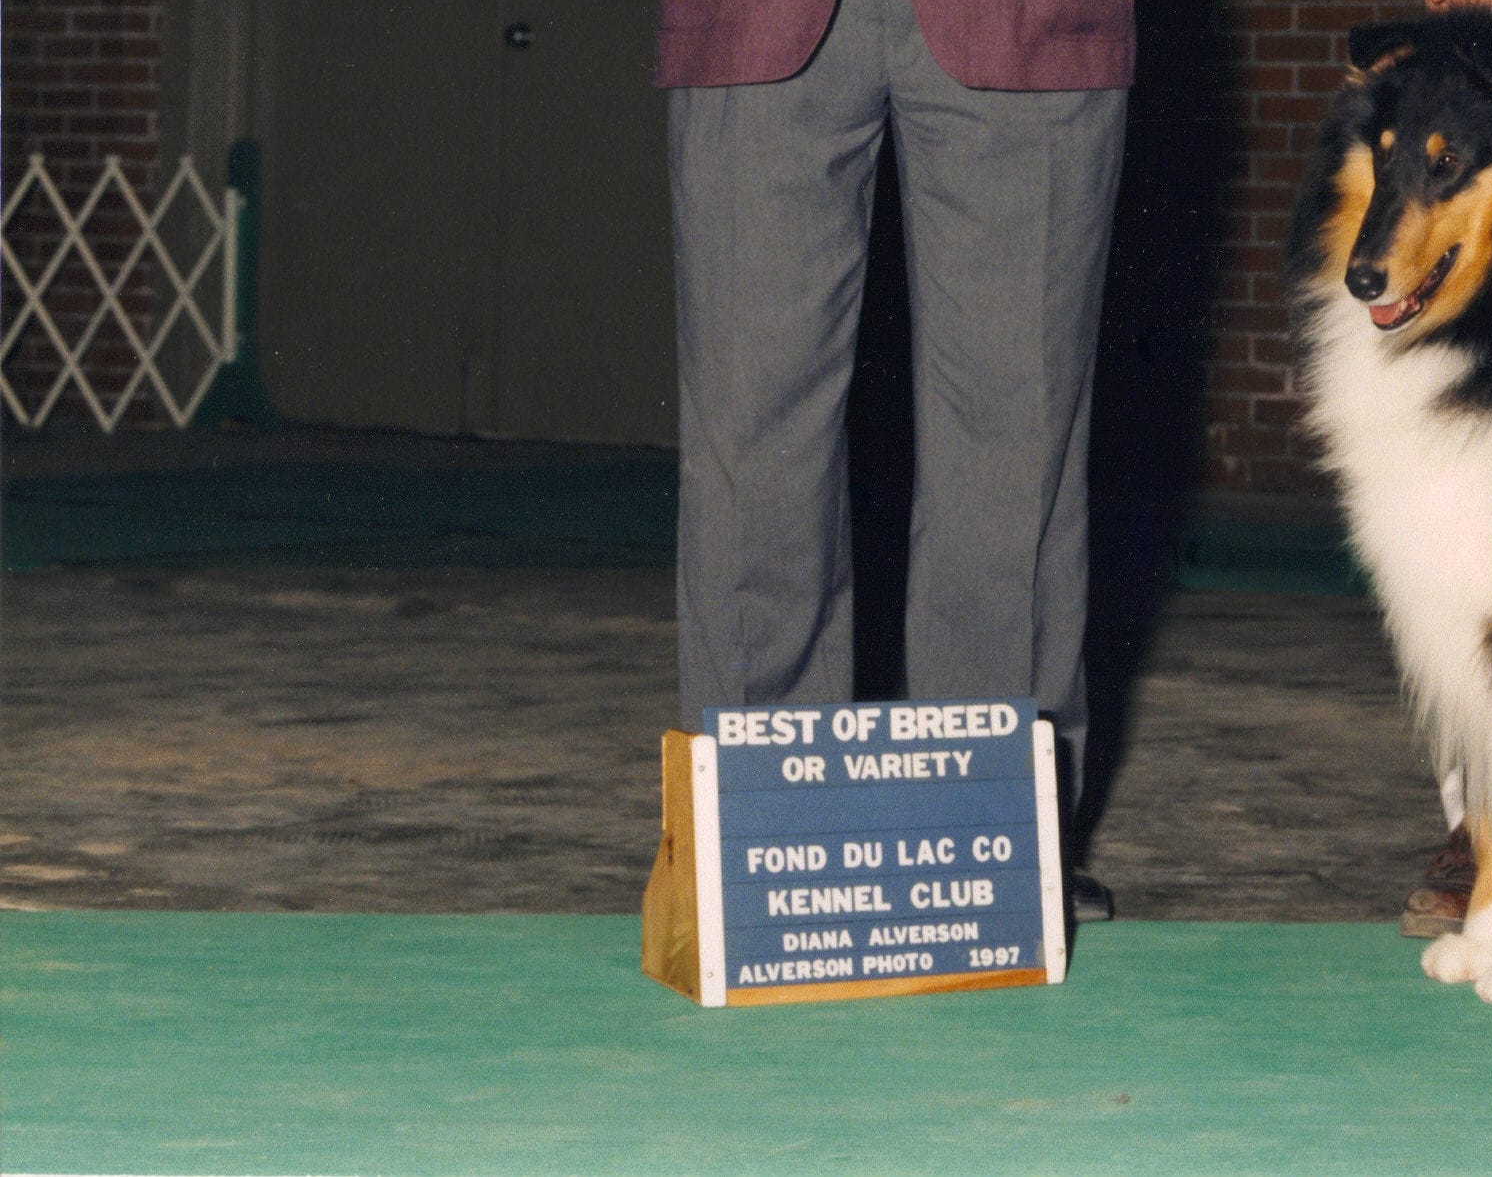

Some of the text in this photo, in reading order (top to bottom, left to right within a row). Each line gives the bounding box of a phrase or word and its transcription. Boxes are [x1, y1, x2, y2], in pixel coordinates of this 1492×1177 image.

[718, 704, 1018, 746] BEST OF BREED
[782, 751, 972, 782] OR VARIETY
[748, 836, 1011, 873] FOND DU LAC CO
[768, 880, 993, 916] KENNEL CLUB
[783, 922, 978, 951] DIANA ALVERSON
[739, 947, 1019, 984] ALVERSON PHOTO 1997
